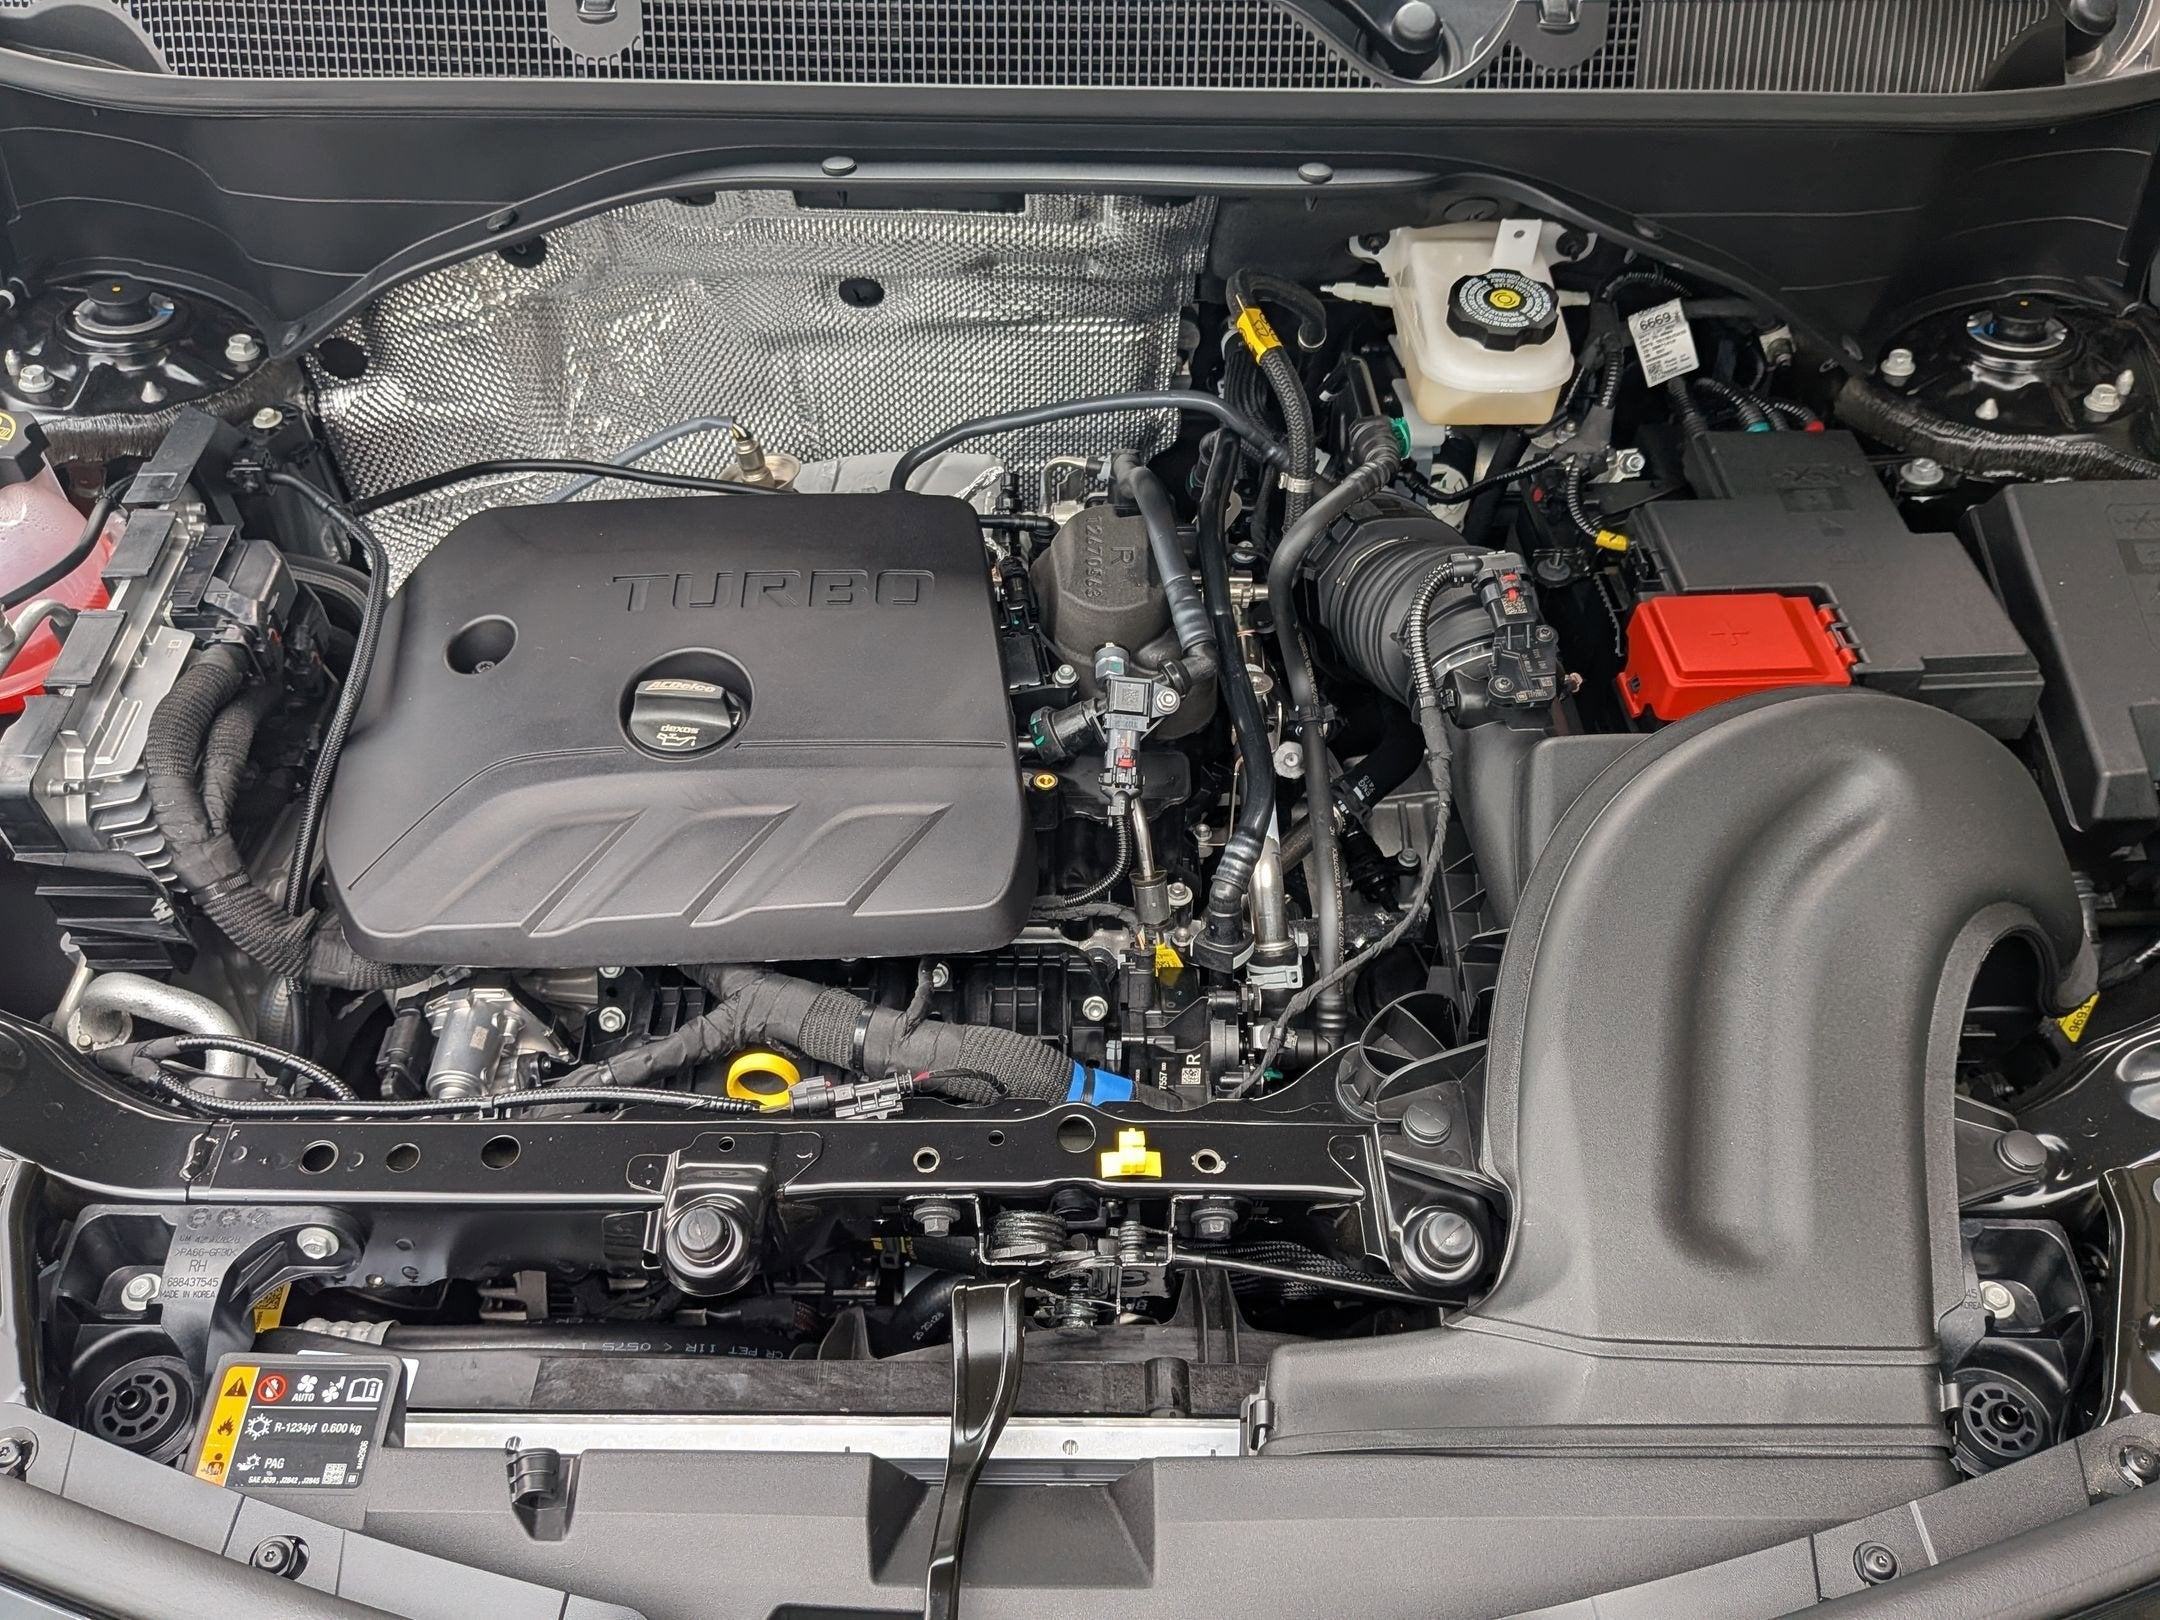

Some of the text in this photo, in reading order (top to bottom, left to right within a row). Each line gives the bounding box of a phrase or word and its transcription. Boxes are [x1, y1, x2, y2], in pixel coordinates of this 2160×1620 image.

[1640, 312, 1671, 331] 6669
[1111, 546, 1136, 565] R
[612, 569, 935, 612] TURBO
[645, 681, 716, 693] ACDelco
[660, 724, 700, 735] dexos
[1186, 1053, 1201, 1065] R
[1159, 1071, 1168, 1090] 7557
[189, 1260, 208, 1272] RH
[167, 1277, 219, 1288] 688437545
[160, 1290, 216, 1298] MADE IN KOREA
[1963, 1301, 1981, 1310] OREA
[602, 1342, 651, 1351] 0575
[728, 1346, 758, 1357] PET
[291, 1393, 315, 1402] AUTO
[273, 1422, 362, 1435] R-1234yf 0.600 kg
[264, 1458, 285, 1469] PAG
[248, 1476, 261, 1484] SAE
